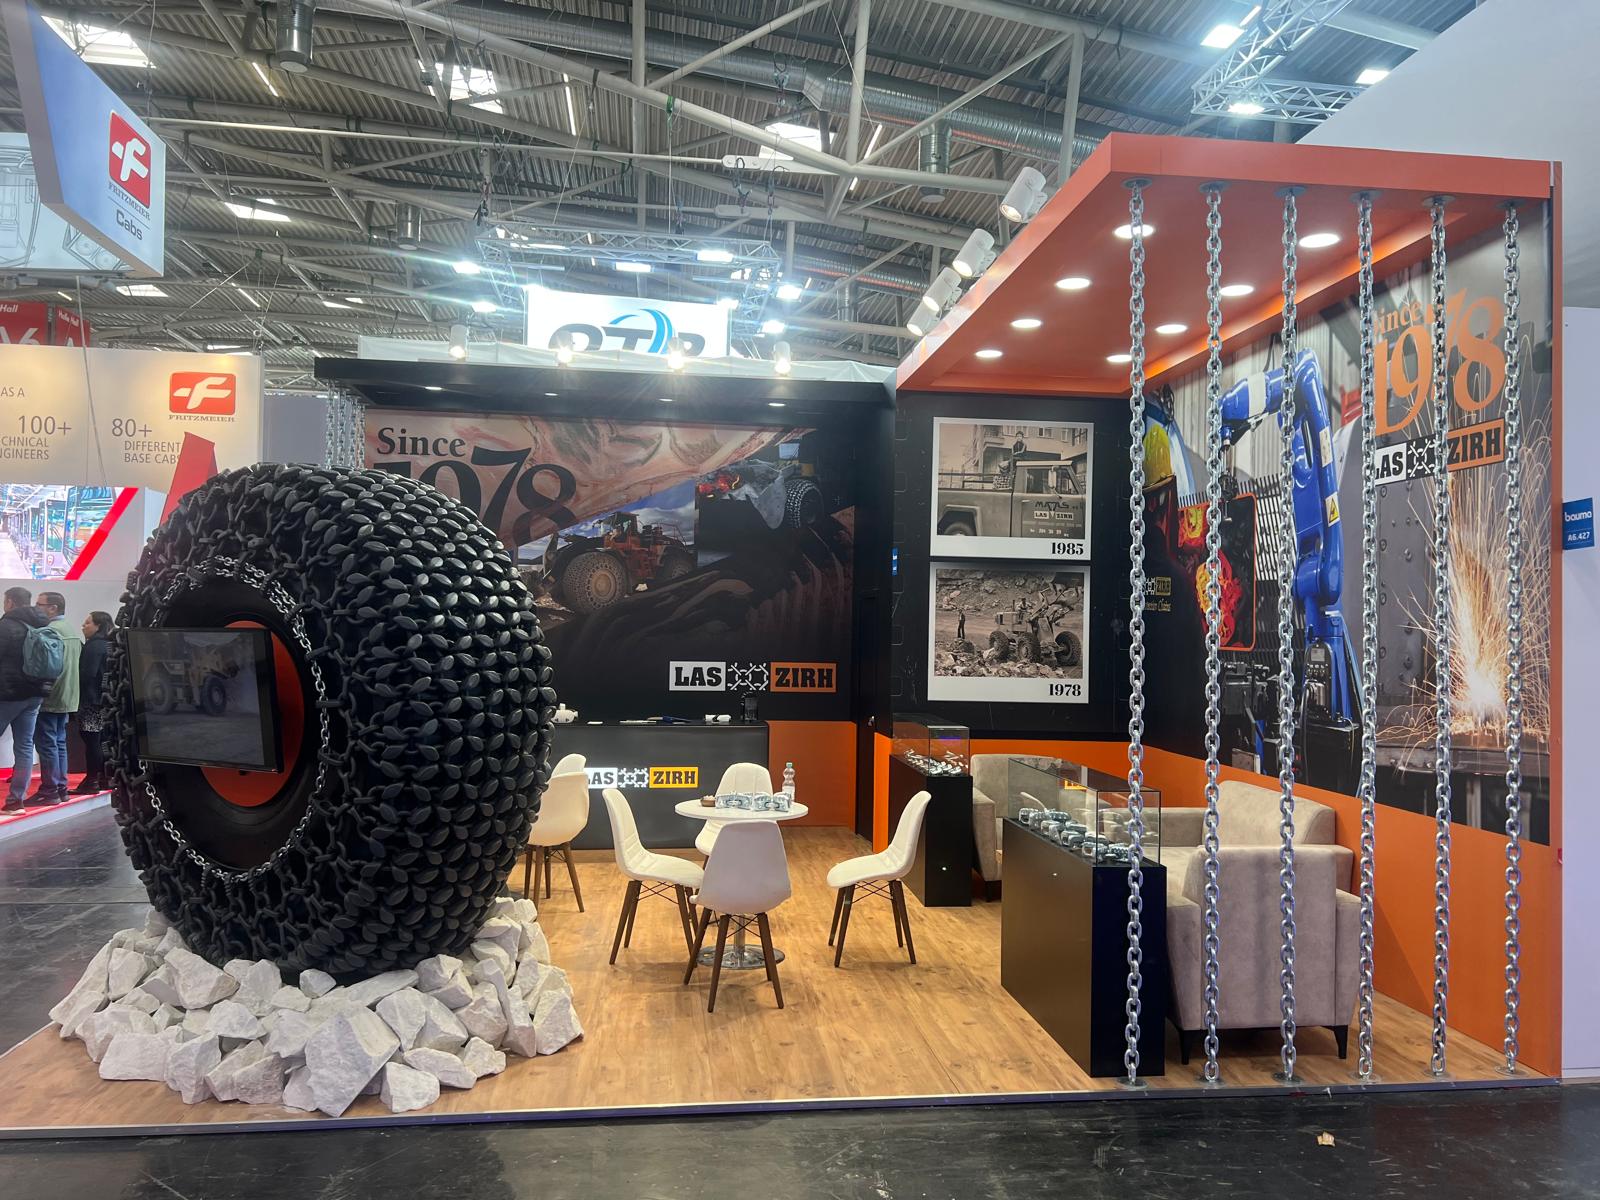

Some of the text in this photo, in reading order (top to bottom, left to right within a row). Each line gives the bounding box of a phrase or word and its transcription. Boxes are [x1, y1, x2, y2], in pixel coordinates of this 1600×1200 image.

[109, 181, 151, 220] FRITZMEIER
[116, 209, 143, 241] Cabs
[0, 304, 19, 313] Hall
[1374, 301, 1422, 336] ince
[17, 387, 25, 398] A
[169, 414, 235, 422] FRITZMEIER
[18, 415, 72, 436] 100+
[111, 418, 152, 438] 80+
[124, 441, 181, 453] DIFFERENT
[376, 427, 466, 457] Since
[124, 453, 151, 463] BASE
[1375, 427, 1501, 480] AS ZIRH
[1564, 511, 1593, 522] bauma
[1567, 531, 1591, 542] A6.427
[1051, 542, 1084, 555] 1985
[674, 666, 834, 688] LAS ZIRH
[1049, 683, 1081, 696] 1978
[653, 770, 696, 785] ZIRH
